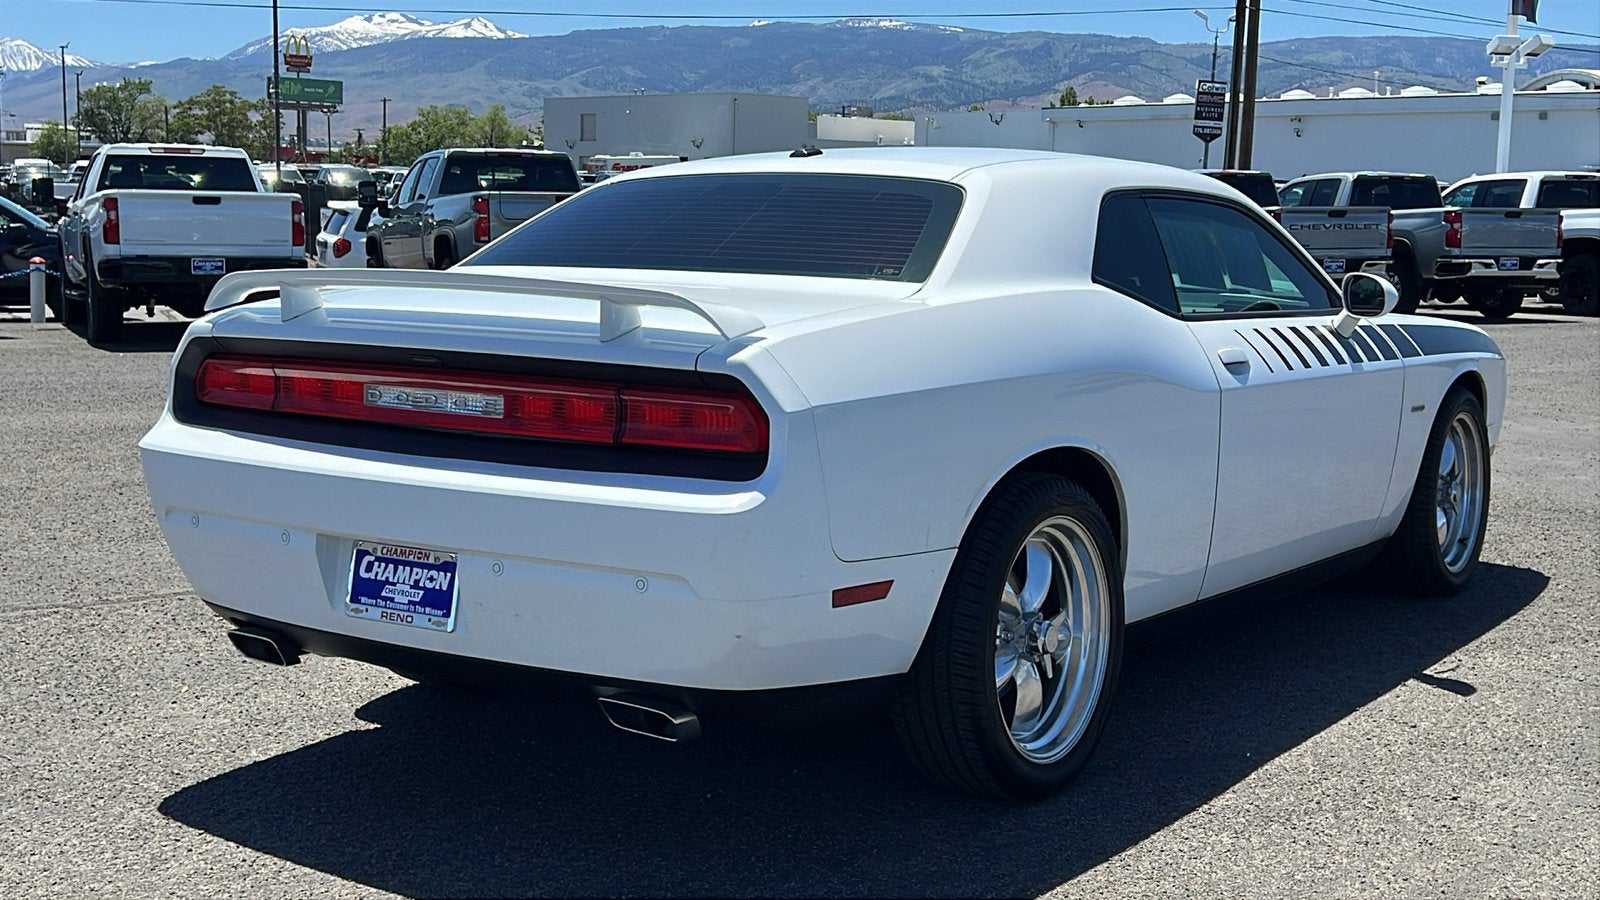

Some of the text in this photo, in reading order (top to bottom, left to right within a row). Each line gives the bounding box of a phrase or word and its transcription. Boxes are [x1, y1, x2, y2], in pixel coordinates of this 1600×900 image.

[1198, 94, 1225, 103] GMC
[1289, 223, 1382, 231] CHEVROLET
[367, 388, 498, 412] DODGE
[380, 546, 430, 561] CHAMPION
[359, 555, 452, 591] CHAMPION
[384, 587, 420, 599] CHEVROLET
[380, 611, 414, 624] RENO
